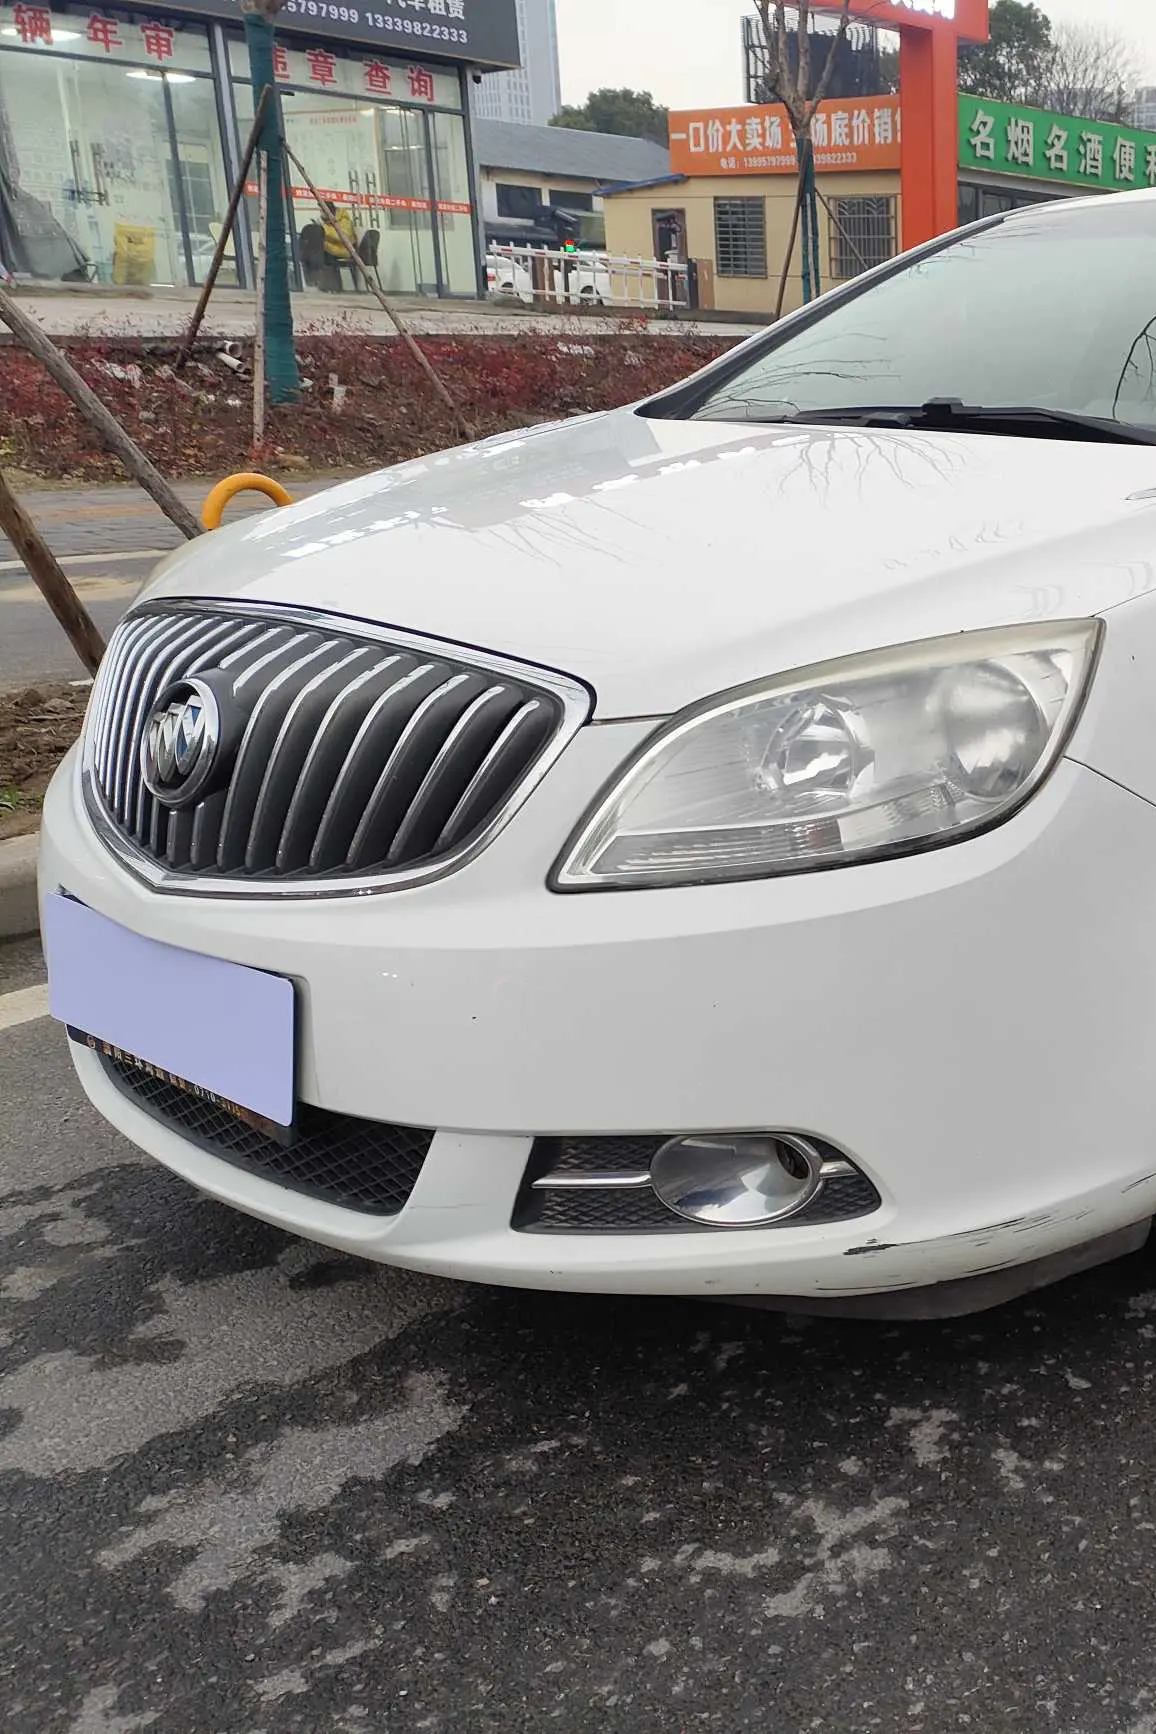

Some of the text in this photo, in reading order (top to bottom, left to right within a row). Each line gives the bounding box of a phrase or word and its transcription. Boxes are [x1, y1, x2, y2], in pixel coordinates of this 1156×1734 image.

[12, 4, 175, 62] 辆年审
[281, 0, 468, 43] 5797999 13339822333
[670, 107, 901, 154] 一口价大卖场 场底价销
